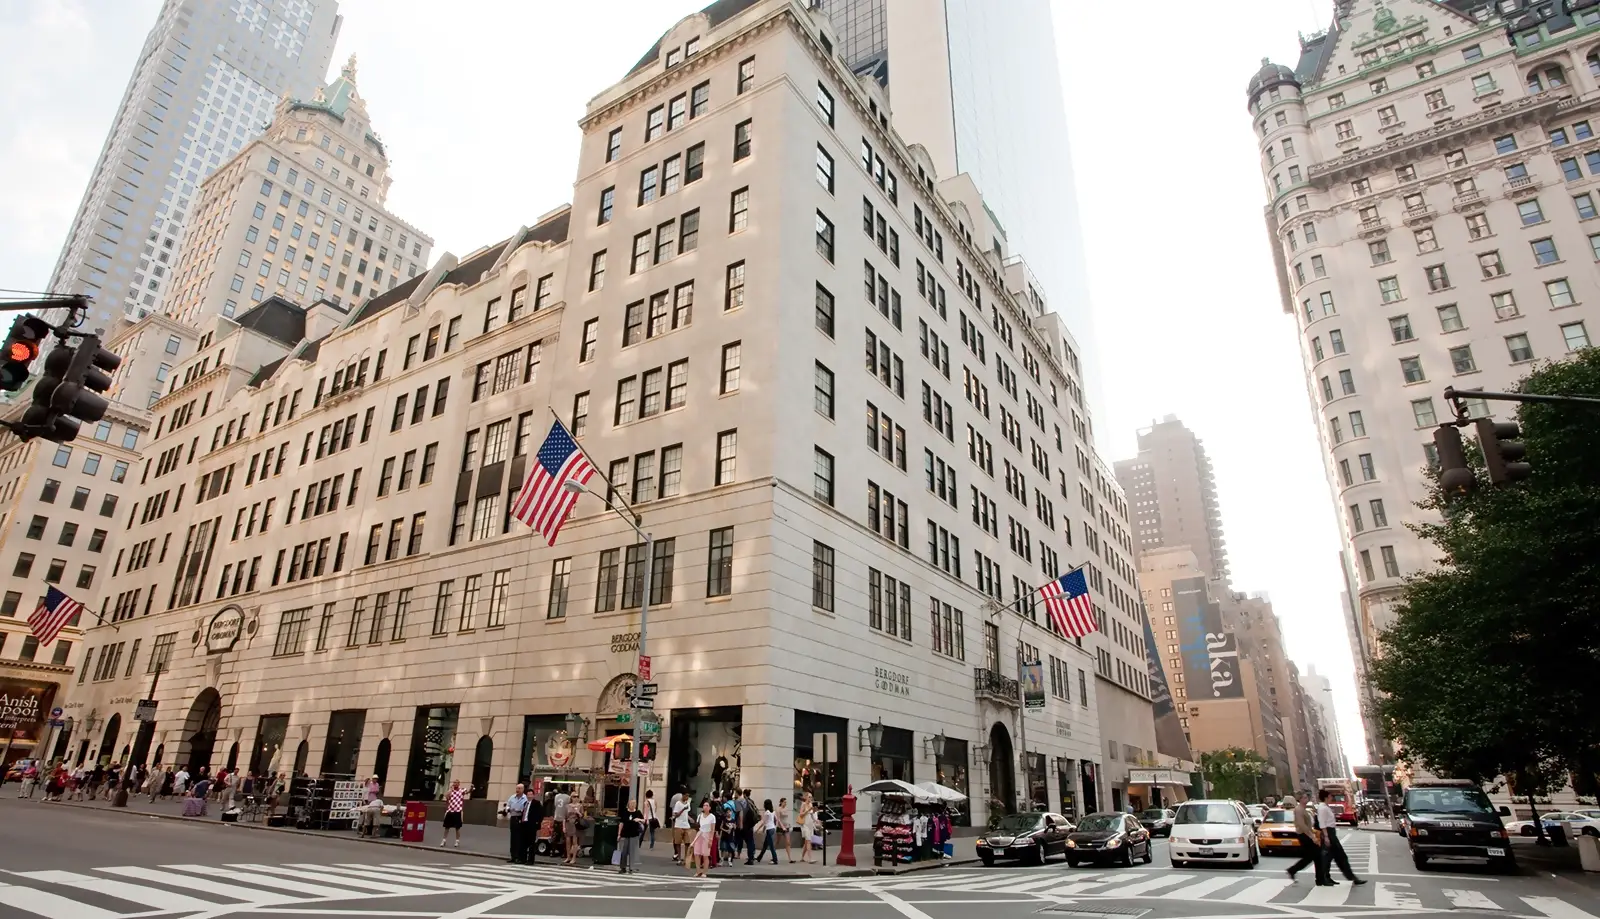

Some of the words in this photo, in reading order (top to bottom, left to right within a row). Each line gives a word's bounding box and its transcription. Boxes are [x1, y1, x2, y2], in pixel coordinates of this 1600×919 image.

[874, 666, 910, 685] BERGDORF
[874, 679, 910, 696] GOODMAN
[0, 693, 38, 709] Anish
